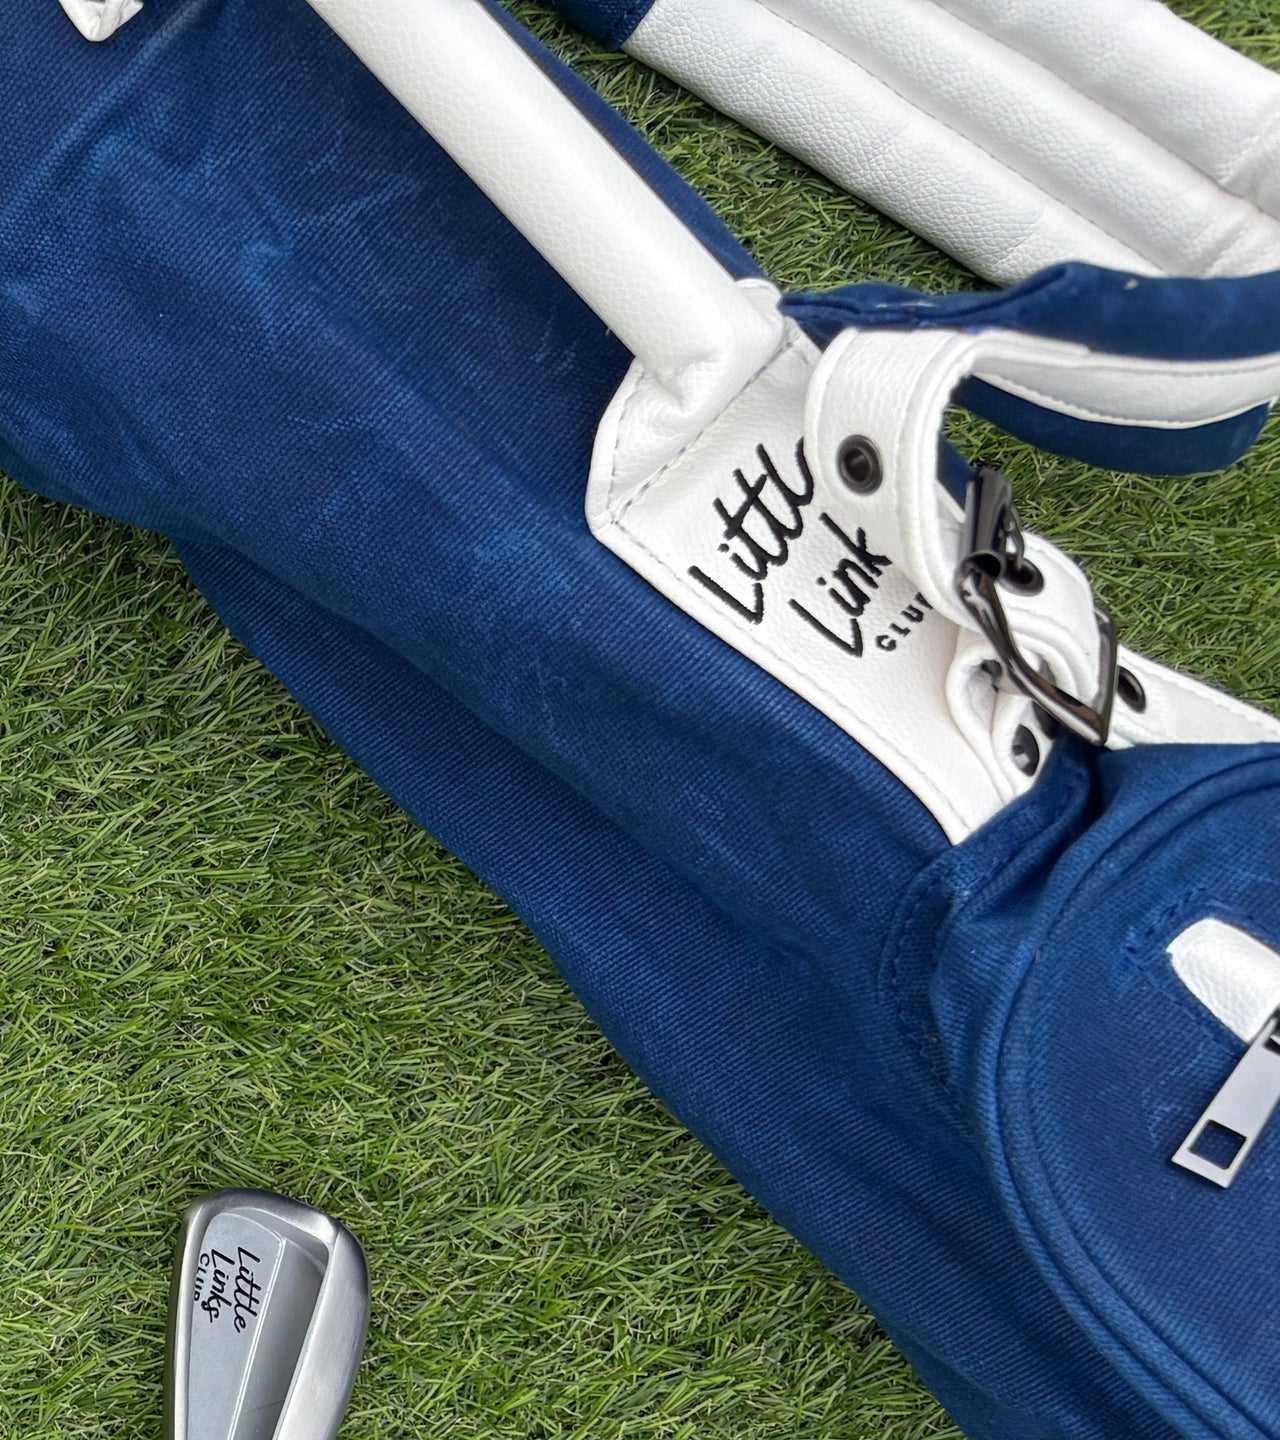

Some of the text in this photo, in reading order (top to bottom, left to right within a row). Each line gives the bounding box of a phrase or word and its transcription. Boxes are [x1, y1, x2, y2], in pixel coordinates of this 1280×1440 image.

[688, 436, 814, 625] Littl
[790, 512, 893, 658] Link
[201, 1248, 236, 1324] Links
[233, 1246, 262, 1334] Little
